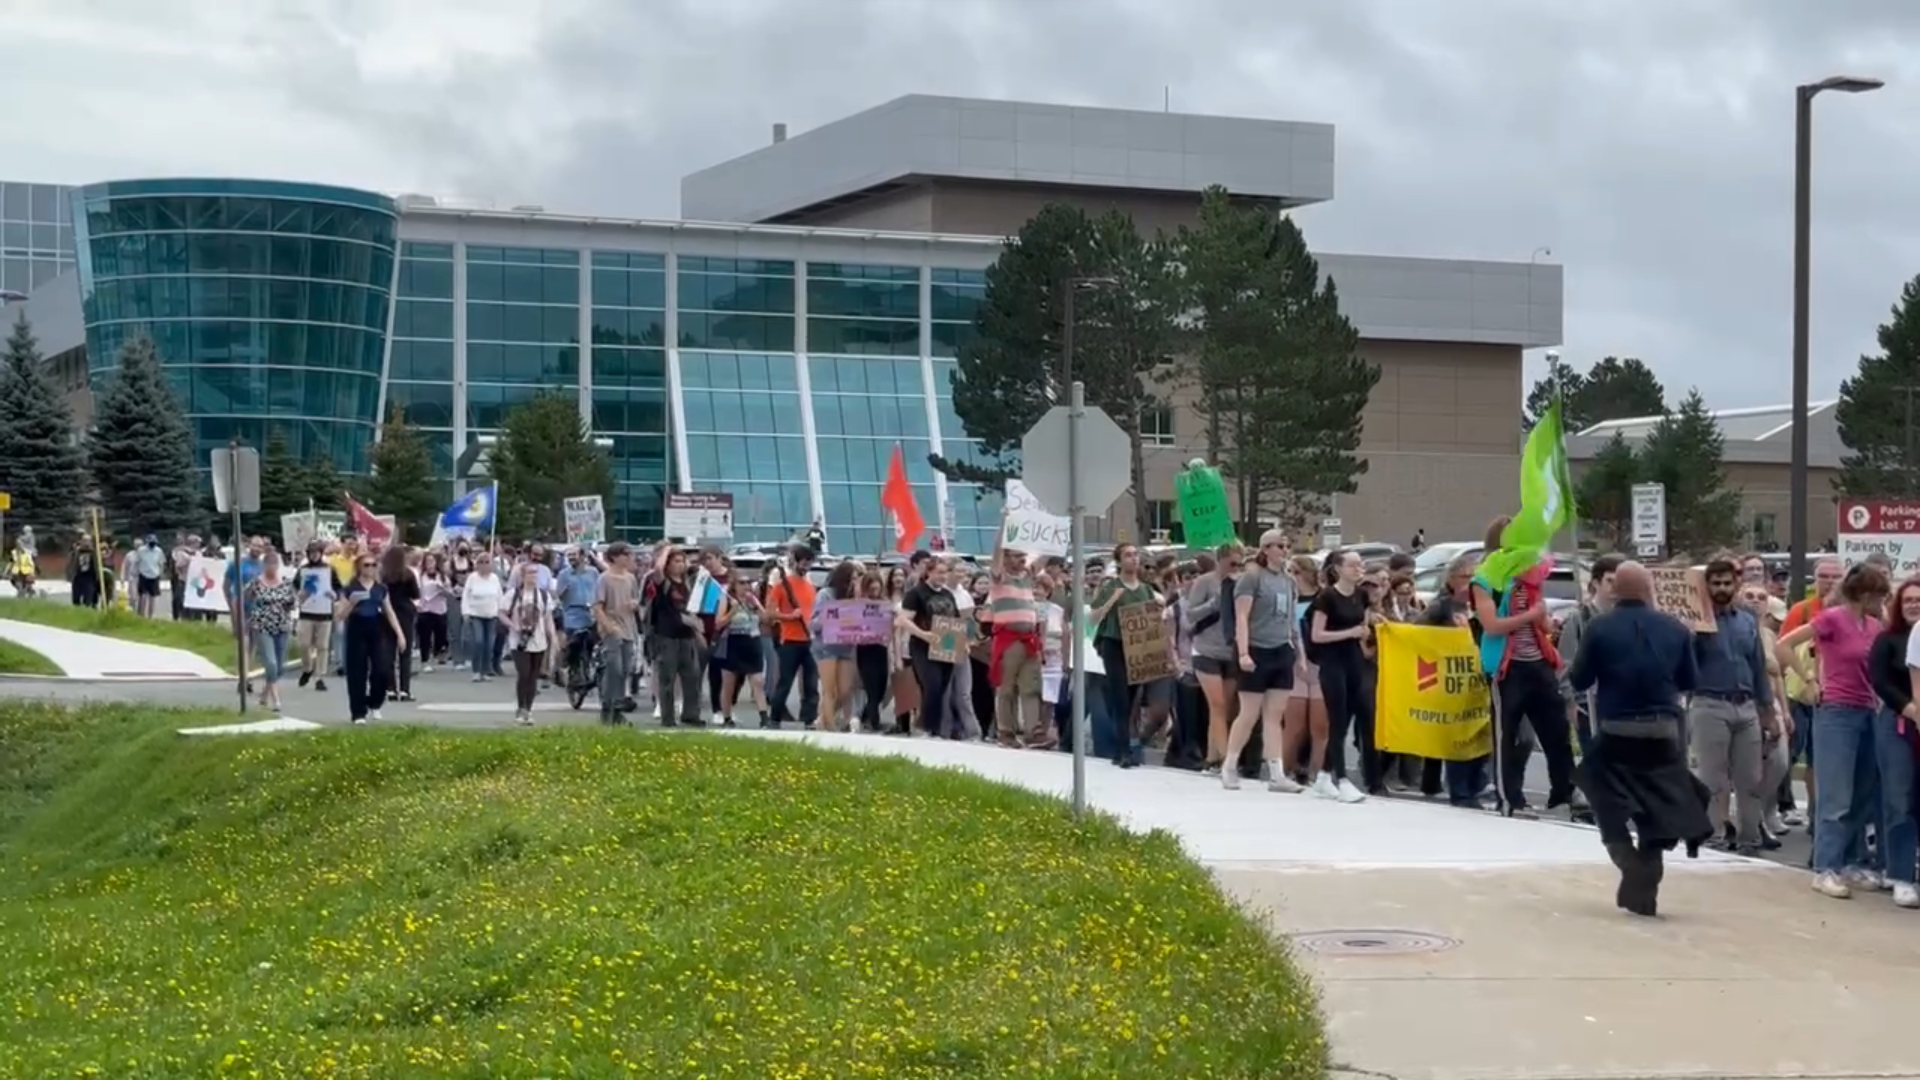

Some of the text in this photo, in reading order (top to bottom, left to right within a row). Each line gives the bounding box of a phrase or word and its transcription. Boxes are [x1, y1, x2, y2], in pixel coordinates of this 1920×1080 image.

[1880, 505, 1920, 518] Parking
[1880, 519, 1916, 530] Lot 17
[1845, 540, 1903, 555] Parking by
[1652, 570, 1685, 581] MAKE
[1657, 595, 1691, 609] COOL
[1444, 656, 1475, 674] THE
[1445, 676, 1465, 695] OF
